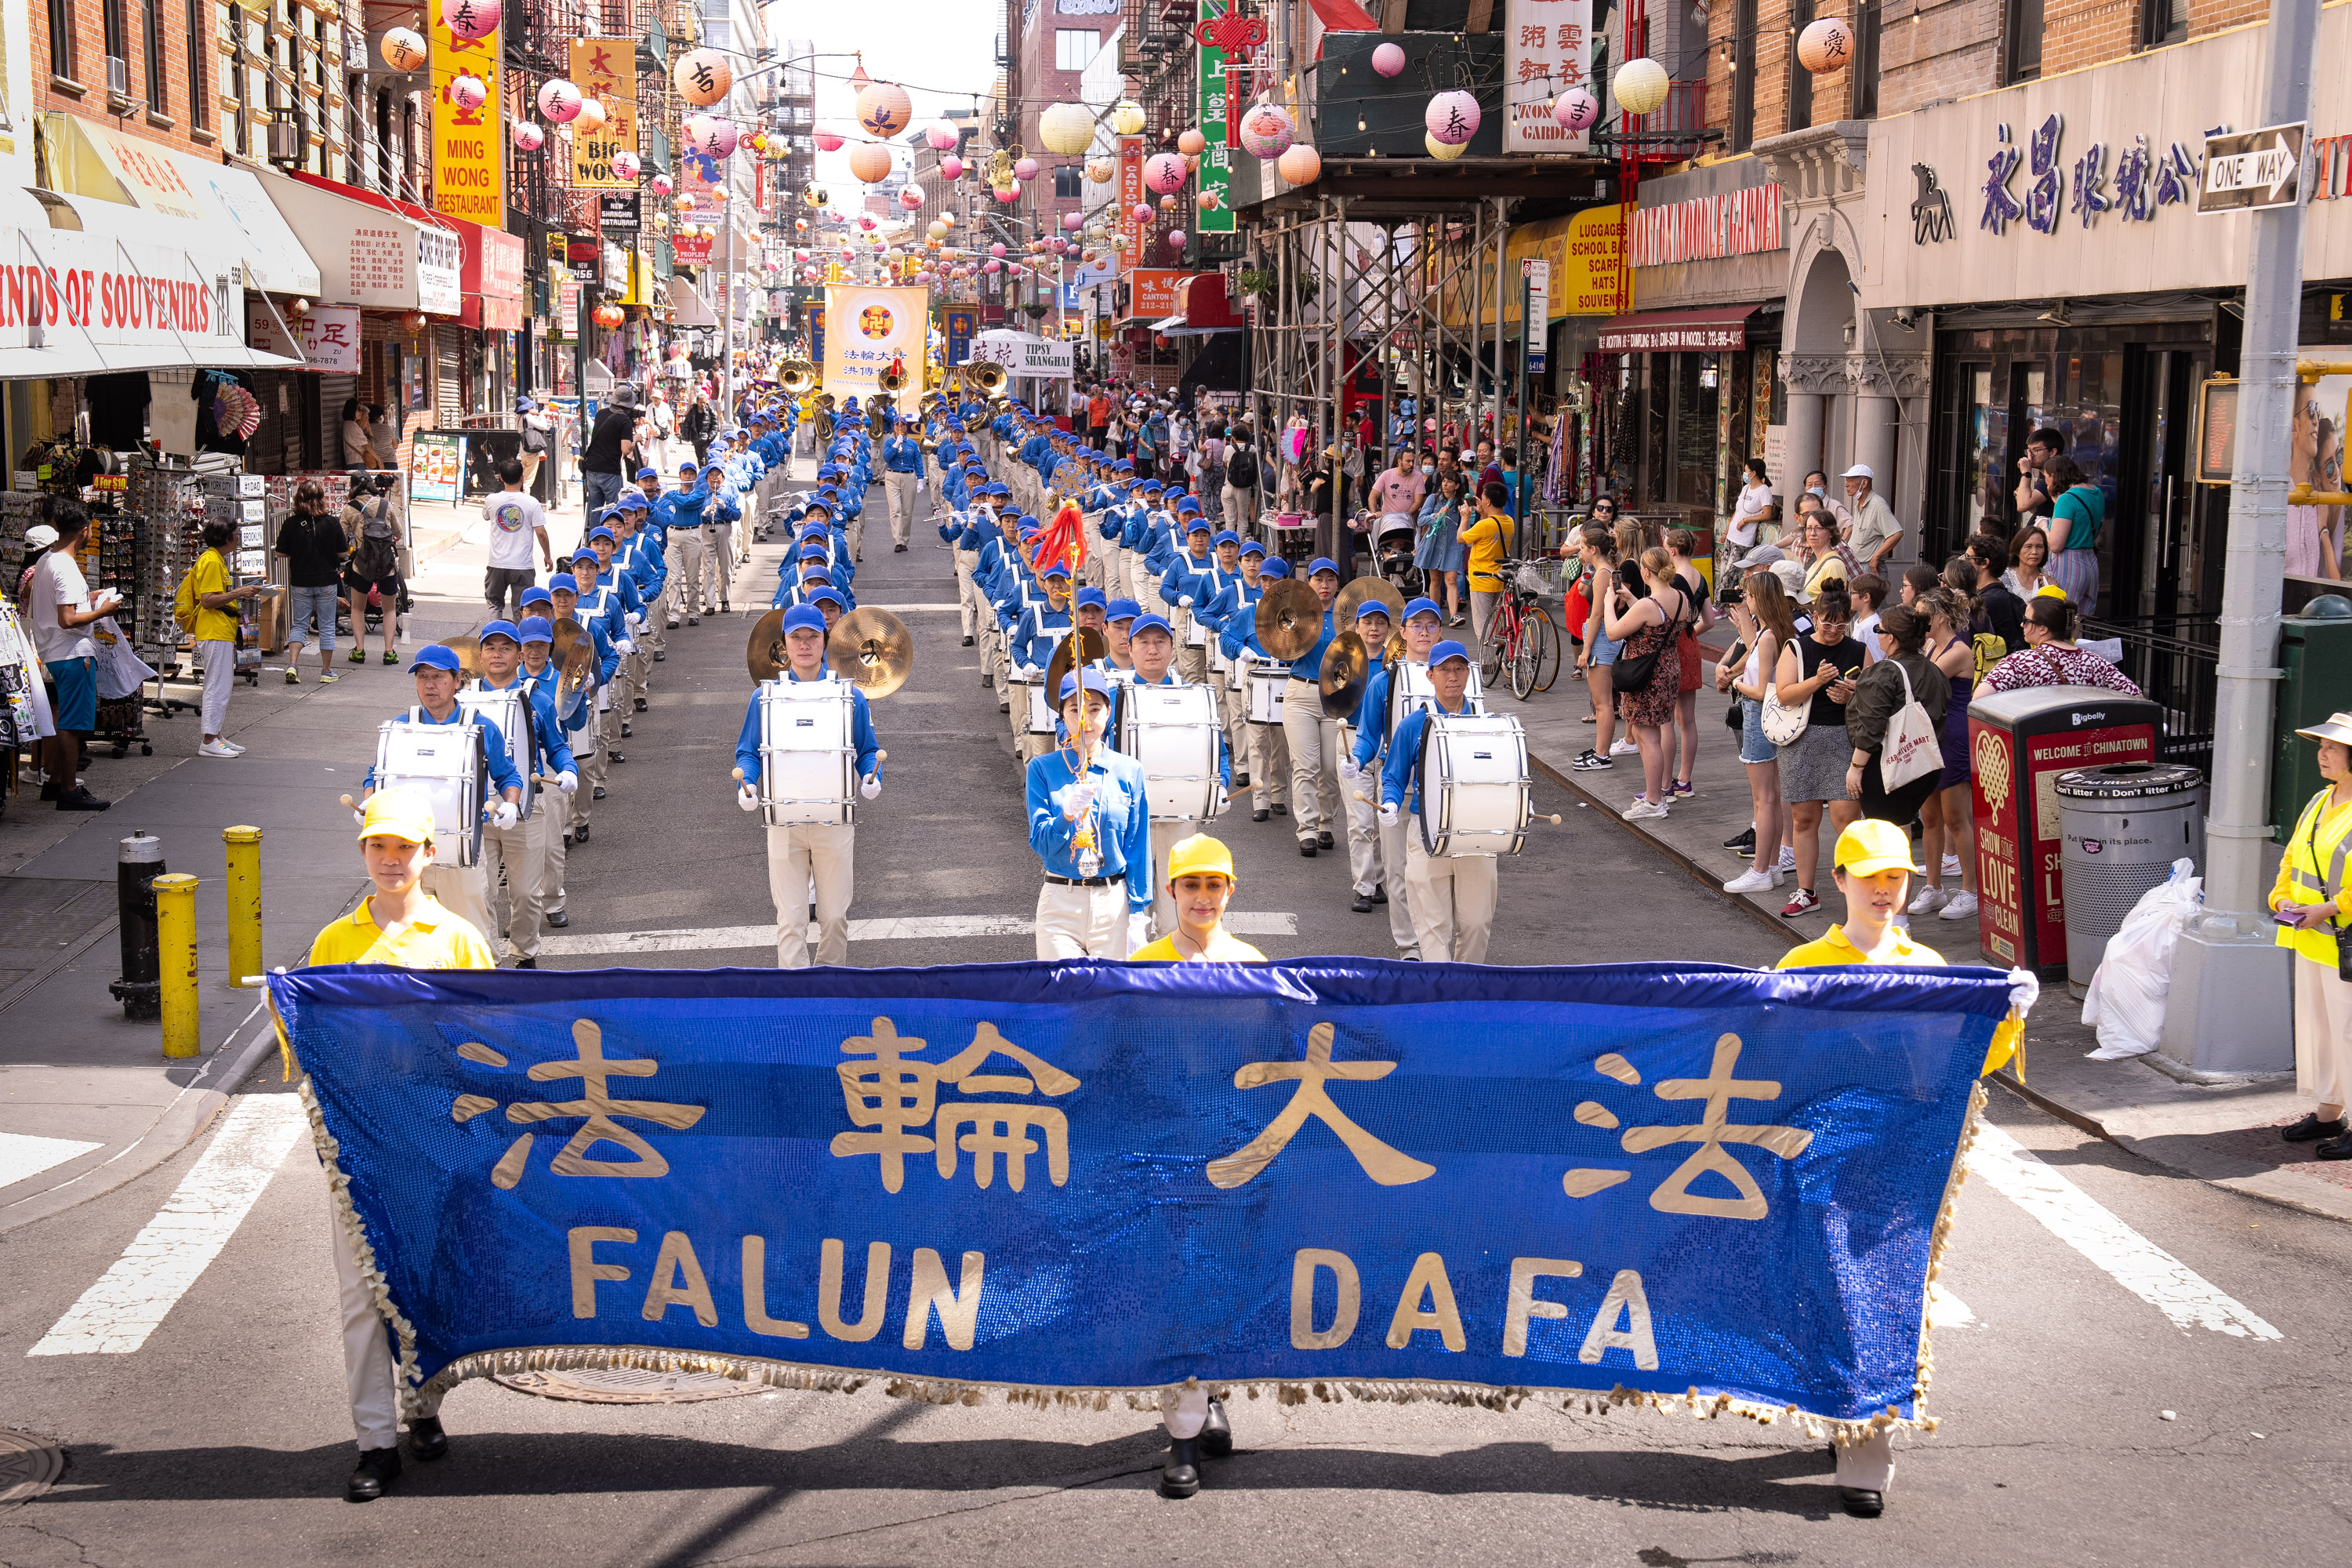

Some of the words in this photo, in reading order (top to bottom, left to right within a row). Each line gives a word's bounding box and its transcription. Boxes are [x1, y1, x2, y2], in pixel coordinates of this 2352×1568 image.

[452, 0, 478, 33] 春
[394, 39, 413, 64] 貴
[1824, 29, 1847, 59] 愛
[690, 62, 724, 94] 吉
[456, 87, 471, 105] 春
[546, 89, 566, 115] 春
[1518, 104, 1556, 118] WON
[1570, 100, 1590, 122] 吉
[1443, 106, 1471, 138] 春
[519, 132, 533, 147] 春
[1522, 125, 1579, 140] GARDEN
[447, 140, 485, 160] MING
[588, 141, 622, 159] BIG
[705, 132, 724, 154] 春
[578, 163, 633, 182] WON
[618, 158, 630, 176] 吉
[1161, 162, 1179, 185] 春
[2215, 158, 2242, 188] ONE
[2257, 151, 2287, 182] WAY
[443, 167, 489, 187] WONG
[1125, 165, 1138, 207] CANTON
[437, 194, 498, 214] RESTAURANT
[863, 216, 872, 227] 吉
[1139, 208, 1148, 220] 吉
[1674, 194, 1727, 263] NOODLE
[1114, 238, 1123, 248] 吉
[1572, 241, 1608, 256] SCHOOL
[1588, 259, 1618, 273] SCARF
[231, 267, 241, 285] 55B
[1592, 276, 1616, 290] HATS
[66, 268, 94, 327] OF
[101, 271, 209, 333] SOUVENIRS
[254, 319, 269, 330] 59
[1686, 331, 1705, 346] NOODLE
[1025, 343, 1051, 354] TIPSY
[288, 355, 338, 365] 212796-7878
[1025, 356, 1070, 367] SHANGHAI
[93, 477, 99, 489] 4
[100, 477, 112, 489] For
[112, 476, 127, 490] $10
[245, 481, 260, 492] #1DAD
[216, 506, 231, 517] YORK
[243, 532, 263, 542] BROOKLYN
[2071, 712, 2106, 726] Bigbelly
[1886, 754, 1898, 766] PEAR
[1913, 735, 1929, 746] MART
[2034, 745, 2082, 761] WELCOME
[2084, 745, 2092, 753] TO
[2093, 738, 2148, 755] CHINATOWN
[2056, 785, 2071, 795] Don't
[2073, 787, 2093, 797] litter
[2112, 788, 2141, 797] Don't
[2145, 785, 2169, 795] litter
[1980, 827, 2000, 857] SHOW
[2001, 840, 2014, 860] SOME
[2067, 834, 2078, 843] Put
[2099, 837, 2107, 845] in
[2124, 837, 2152, 846] place.
[2045, 853, 2062, 871] SH
[1980, 852, 2017, 910] LOVE
[1994, 904, 2019, 937] CLEAN
[2047, 910, 2063, 920] KEEP
[452, 1016, 1813, 1220] 法輪大法
[568, 1225, 984, 1351] FALUN
[1290, 1248, 1660, 1370] DAFA
